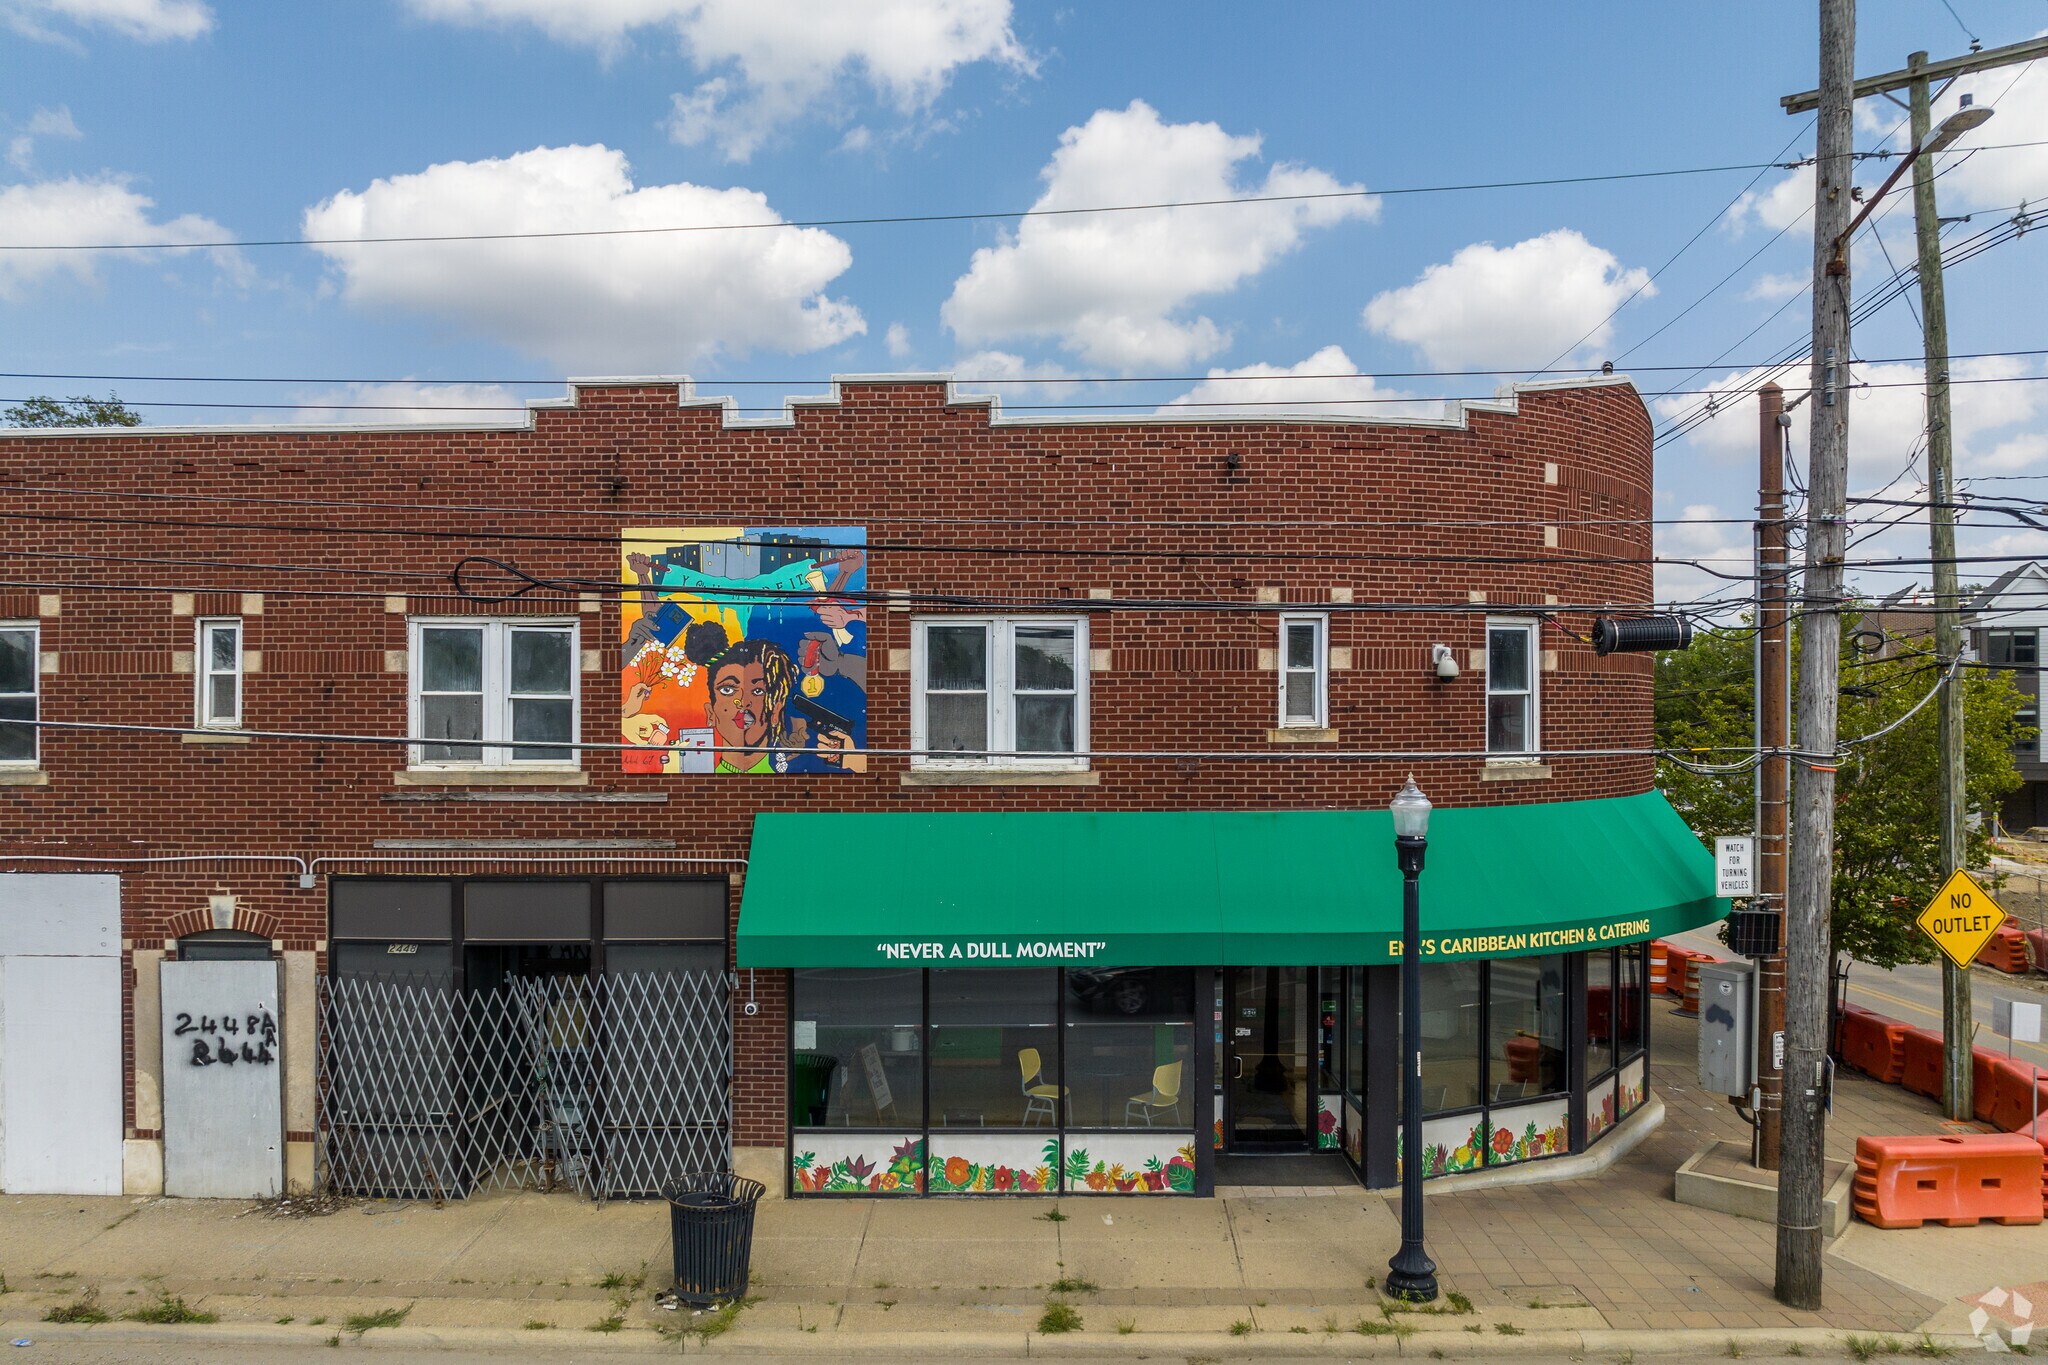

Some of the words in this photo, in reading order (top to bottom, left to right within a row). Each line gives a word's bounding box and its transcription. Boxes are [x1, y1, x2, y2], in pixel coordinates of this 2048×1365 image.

[682, 575, 721, 595] YO
[807, 677, 817, 693] 1
[1725, 843, 1744, 852] WATCH
[1729, 856, 1740, 864] FOR
[1722, 868, 1747, 877] TURNING
[1721, 881, 1749, 889] VEHICLES
[1951, 893, 1971, 909] NO
[1933, 915, 1991, 934] OUTLET
[1389, 940, 1436, 956] E'S
[1440, 934, 1527, 955] CARIBBEAN
[1529, 928, 1584, 948] KITCHEN
[1586, 927, 1597, 942] &
[1599, 918, 1650, 940] CATERING
[389, 944, 417, 953] 2448
[877, 943, 945, 959] “NEVER
[949, 943, 963, 959] A
[967, 942, 1012, 958] DULL
[1016, 942, 1106, 958] MOMENT”
